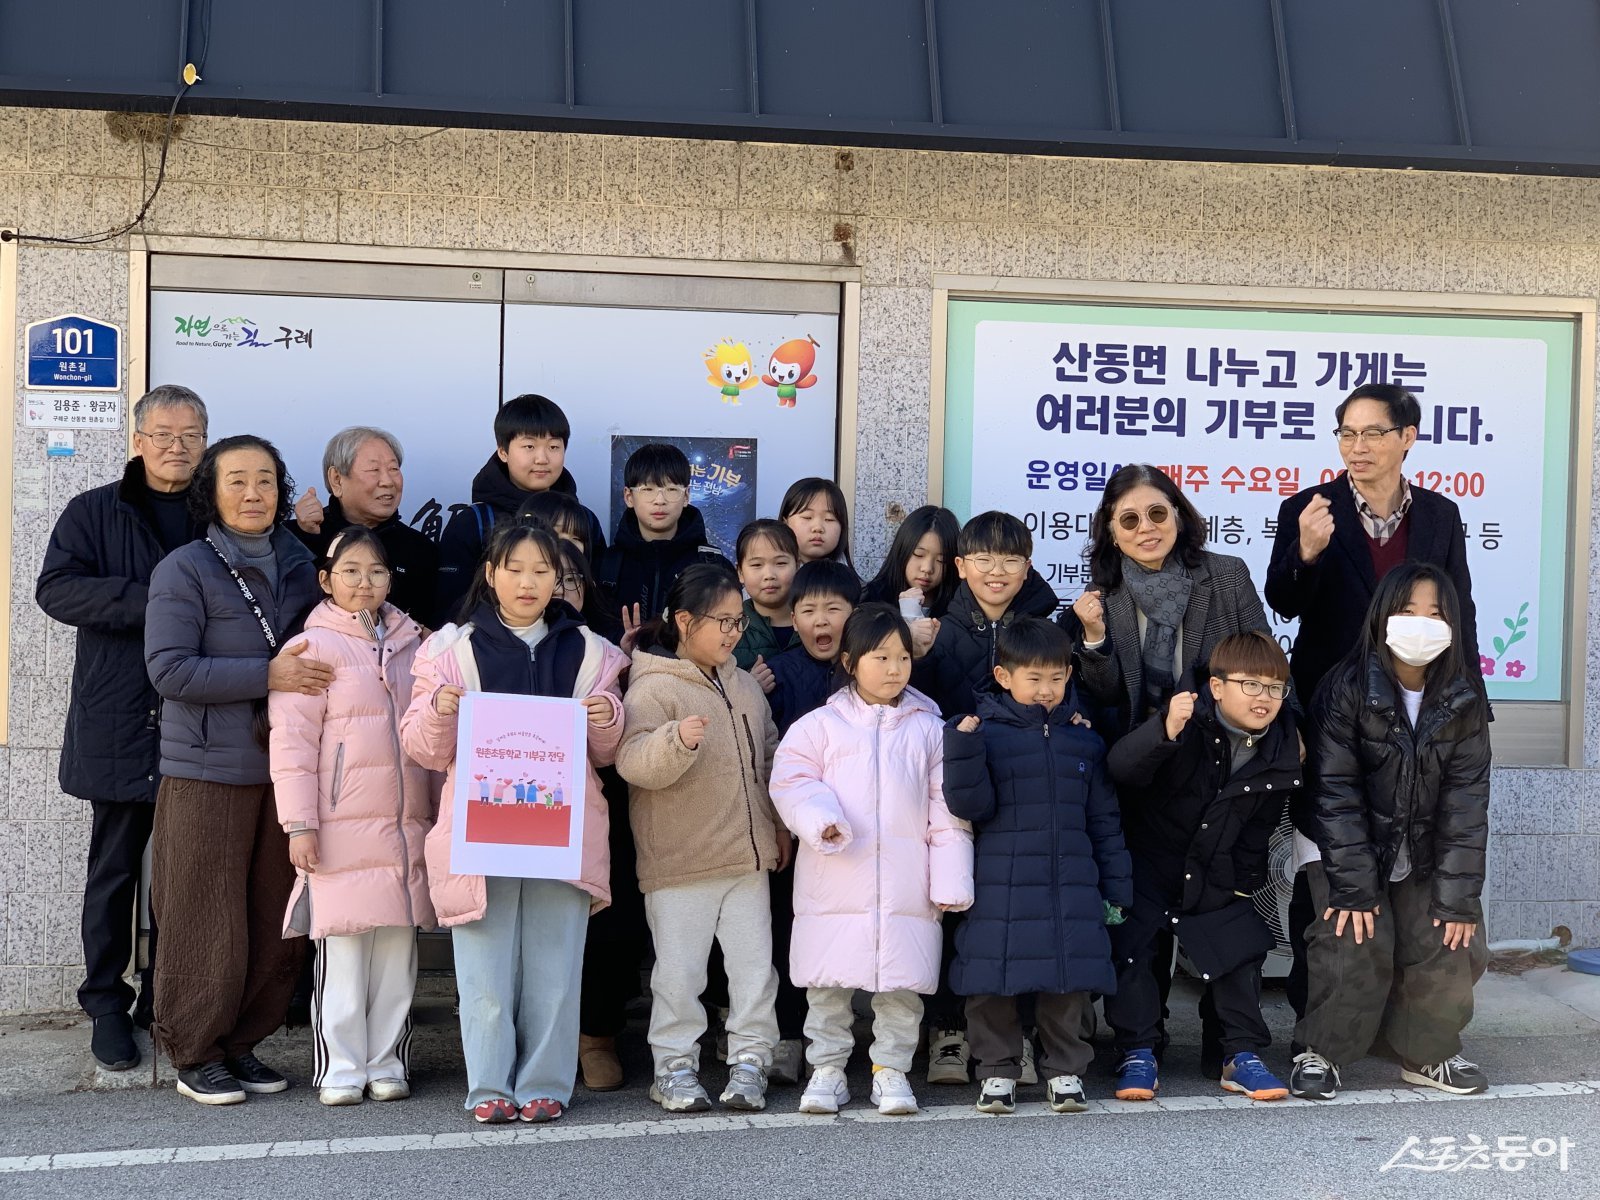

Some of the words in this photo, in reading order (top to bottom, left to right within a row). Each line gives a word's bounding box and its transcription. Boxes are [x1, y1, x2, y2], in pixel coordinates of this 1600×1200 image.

[52, 328, 93, 355] 101
[274, 326, 313, 350] 구례
[53, 373, 92, 382] Wonchon-gil
[59, 361, 86, 373] 원촌길
[1052, 342, 1167, 385] 산동면
[1186, 346, 1298, 389] 나누고
[1315, 351, 1428, 393] 가게는
[53, 399, 80, 412] 김용준
[89, 400, 117, 412] 왕금자
[1036, 393, 1187, 438] 여러분의
[1204, 399, 1316, 440] 기부로
[1416, 405, 1494, 446] 니다.
[707, 463, 742, 488] 기부
[1026, 460, 1122, 492] 운영일
[1221, 465, 1300, 497] 수요일
[1024, 511, 1093, 541] 이용대
[1479, 522, 1503, 551] 등
[1046, 563, 1092, 584] 기부문
[260, 617, 277, 648] adidas
[475, 746, 522, 760] 원촌초등학교
[523, 750, 546, 762] 기부금
[548, 751, 566, 763] 전달
